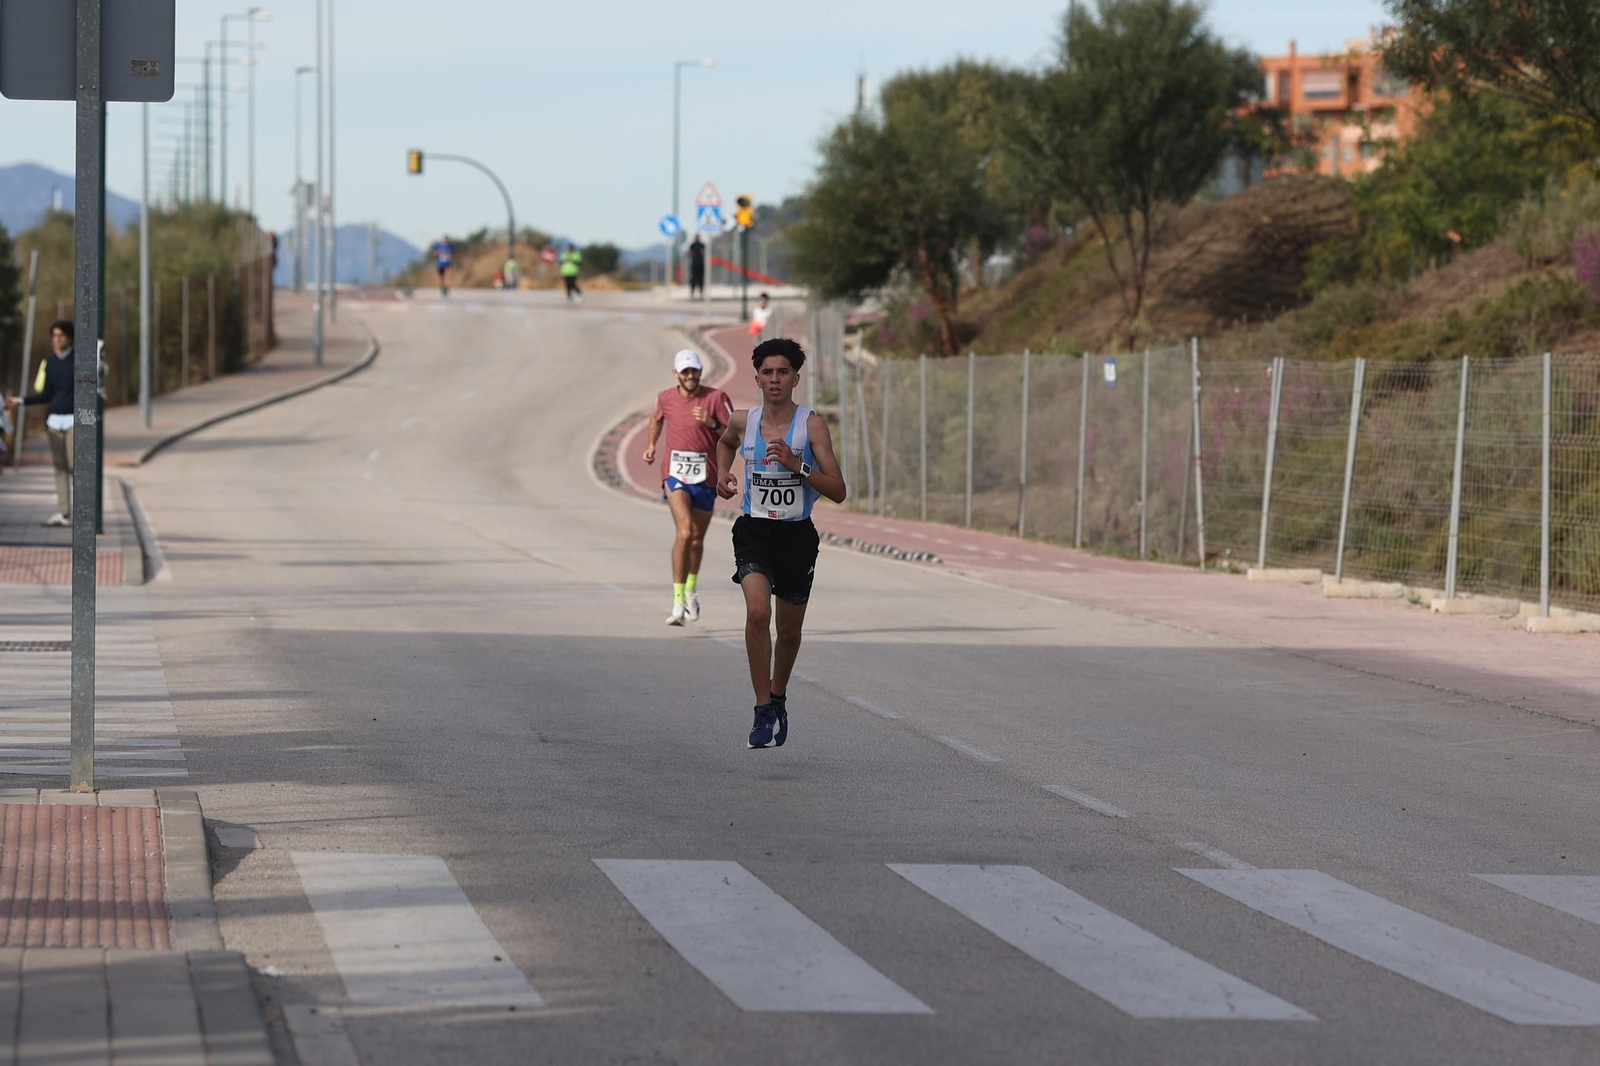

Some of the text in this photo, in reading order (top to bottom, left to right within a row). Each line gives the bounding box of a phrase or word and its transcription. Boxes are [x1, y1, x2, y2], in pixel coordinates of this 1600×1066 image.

[676, 463, 701, 475] 276
[753, 478, 775, 486] UMA
[759, 488, 795, 506] 700
